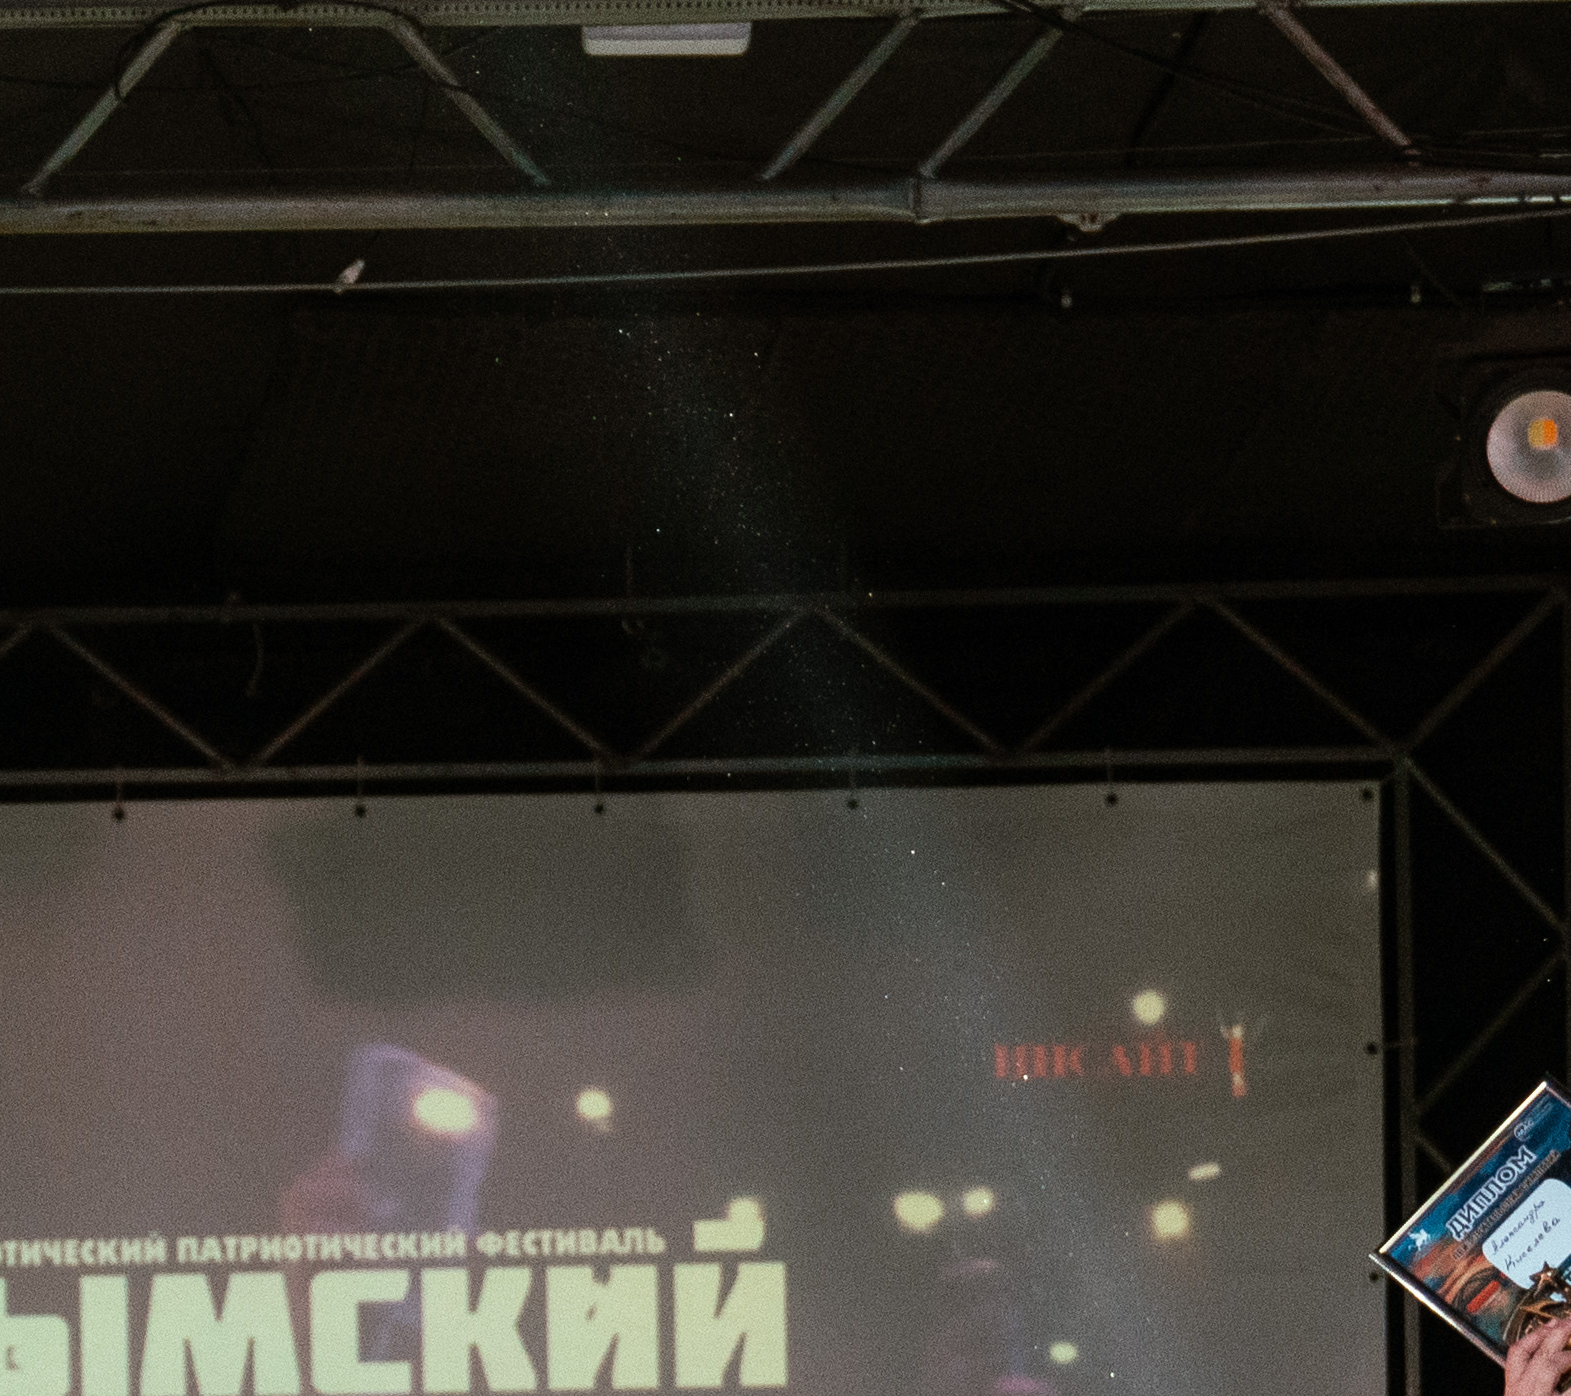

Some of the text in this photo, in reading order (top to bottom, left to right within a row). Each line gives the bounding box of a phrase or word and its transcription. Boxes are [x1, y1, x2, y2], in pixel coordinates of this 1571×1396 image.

[1446, 1144, 1537, 1242] ДИПЛОМ
[175, 1225, 465, 1263] ПАТРИОТИЧЕСКИЙ
[473, 1226, 663, 1258] ФЕСТИВАЛЬ
